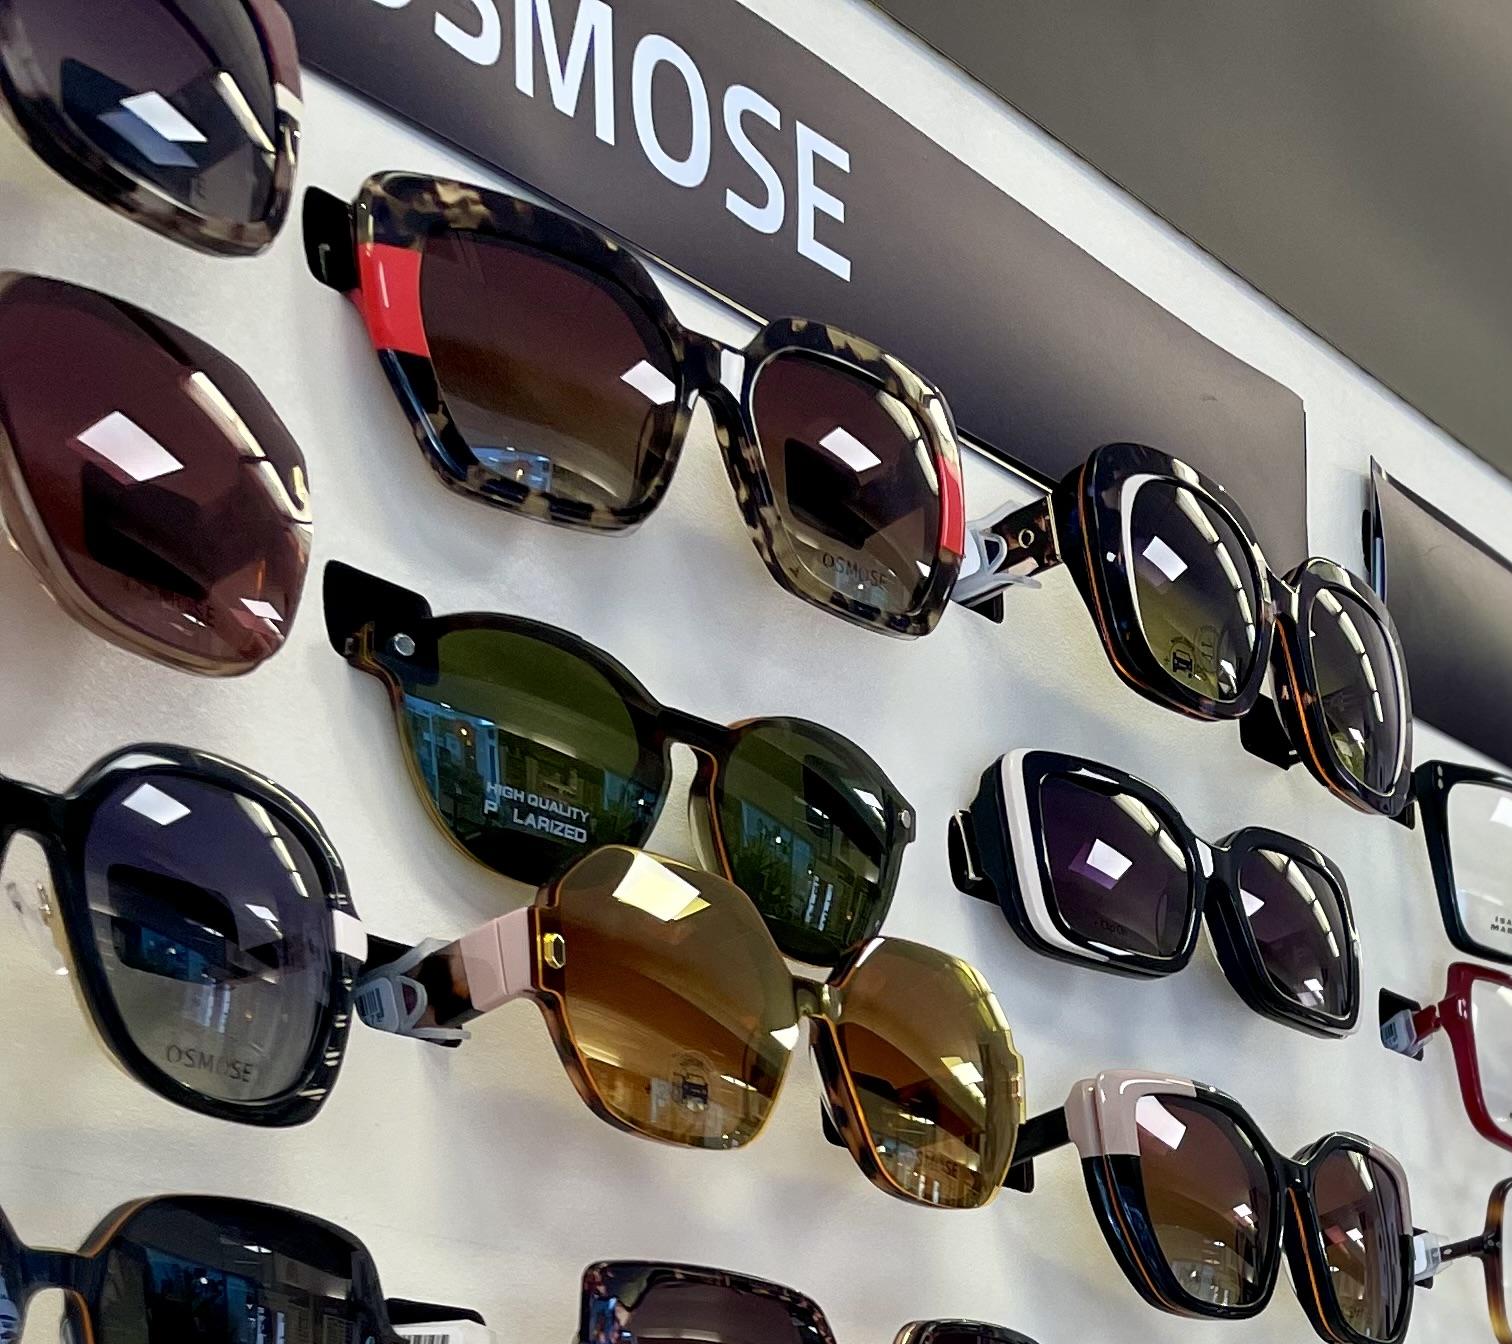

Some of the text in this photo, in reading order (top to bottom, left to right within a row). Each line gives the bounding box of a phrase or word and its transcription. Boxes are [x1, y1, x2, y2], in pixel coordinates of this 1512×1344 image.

[378, 0, 851, 282] MOSE
[486, 782, 589, 823] HIGH QUALITY
[167, 1044, 254, 1083] OSMOSE
